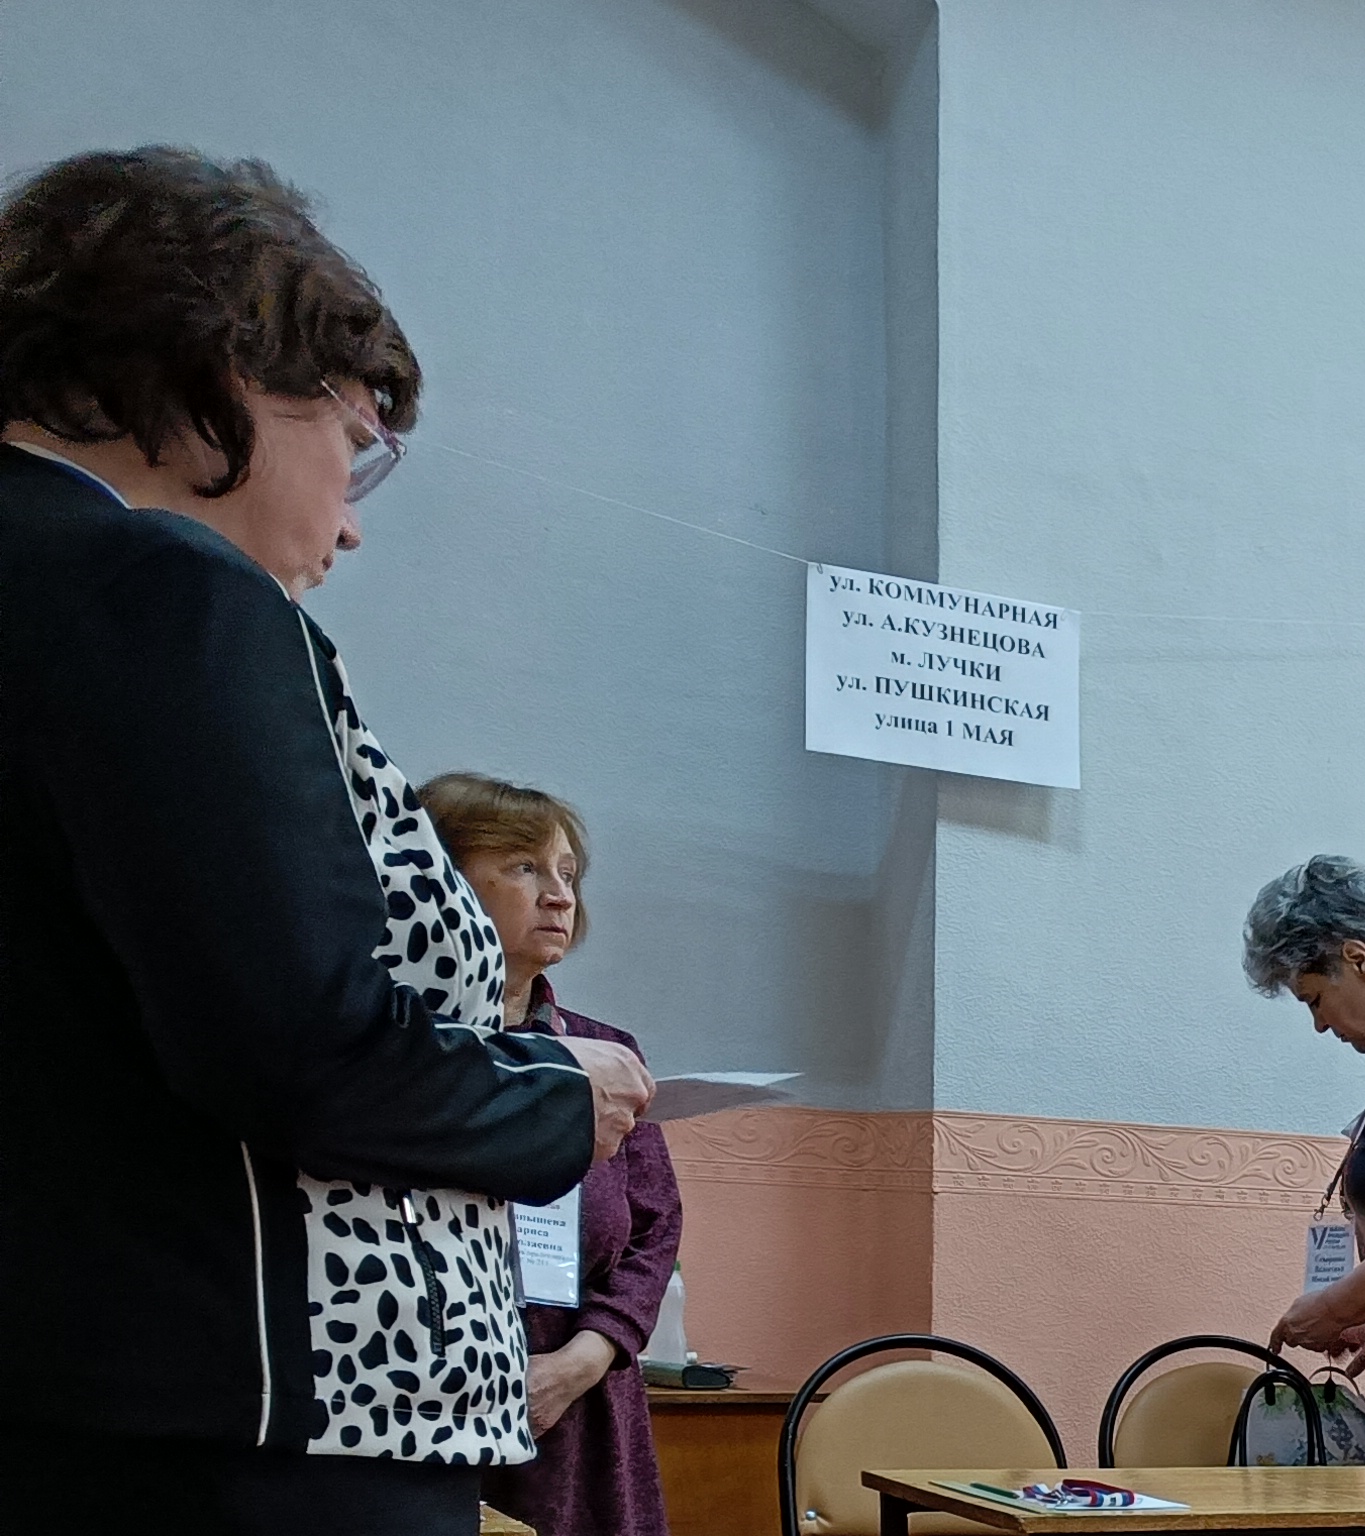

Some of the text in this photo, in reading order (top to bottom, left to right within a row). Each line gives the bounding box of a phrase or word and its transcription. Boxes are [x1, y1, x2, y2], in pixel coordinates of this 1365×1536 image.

[829, 574, 1059, 630] ул. КОММУНАРНАЯ
[842, 609, 1047, 660] ул. А.КУЗНЕЦОВА
[890, 650, 1002, 683] м. ЛУЧКИ
[836, 674, 1050, 722] ул. ПУШКИНСКАЯ
[874, 712, 1015, 747] улица 1 МАЯ
